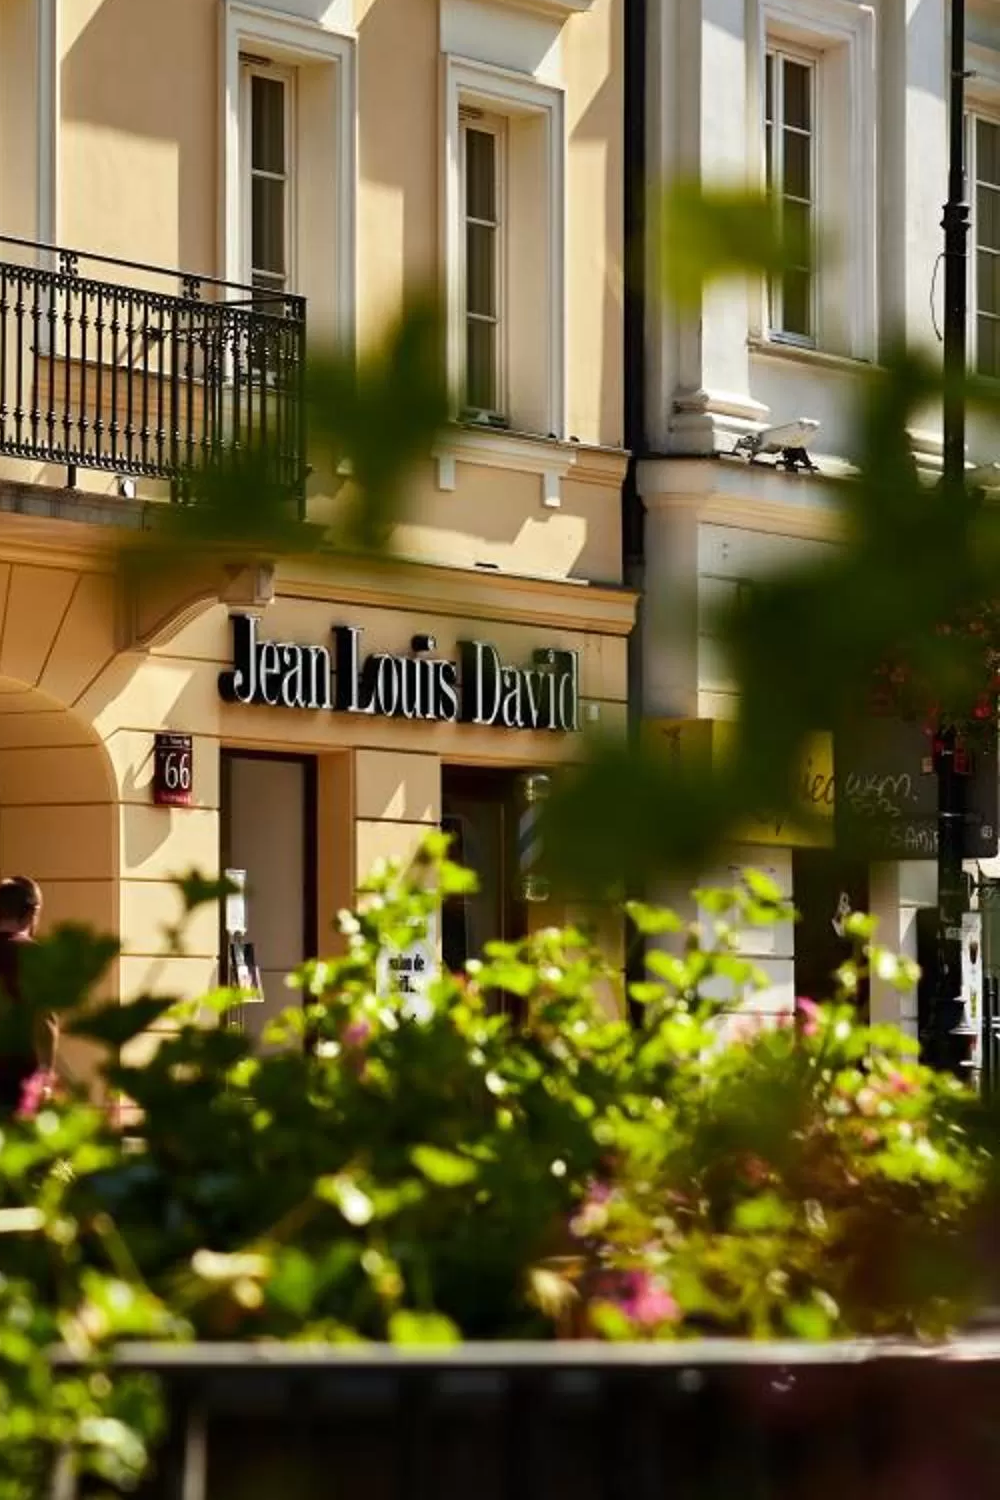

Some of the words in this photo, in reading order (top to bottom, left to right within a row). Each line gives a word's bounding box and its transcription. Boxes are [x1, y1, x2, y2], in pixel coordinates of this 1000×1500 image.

[218, 613, 333, 708] Jean
[332, 626, 459, 722] Louis
[460, 639, 581, 732] David
[165, 752, 190, 789] 66
